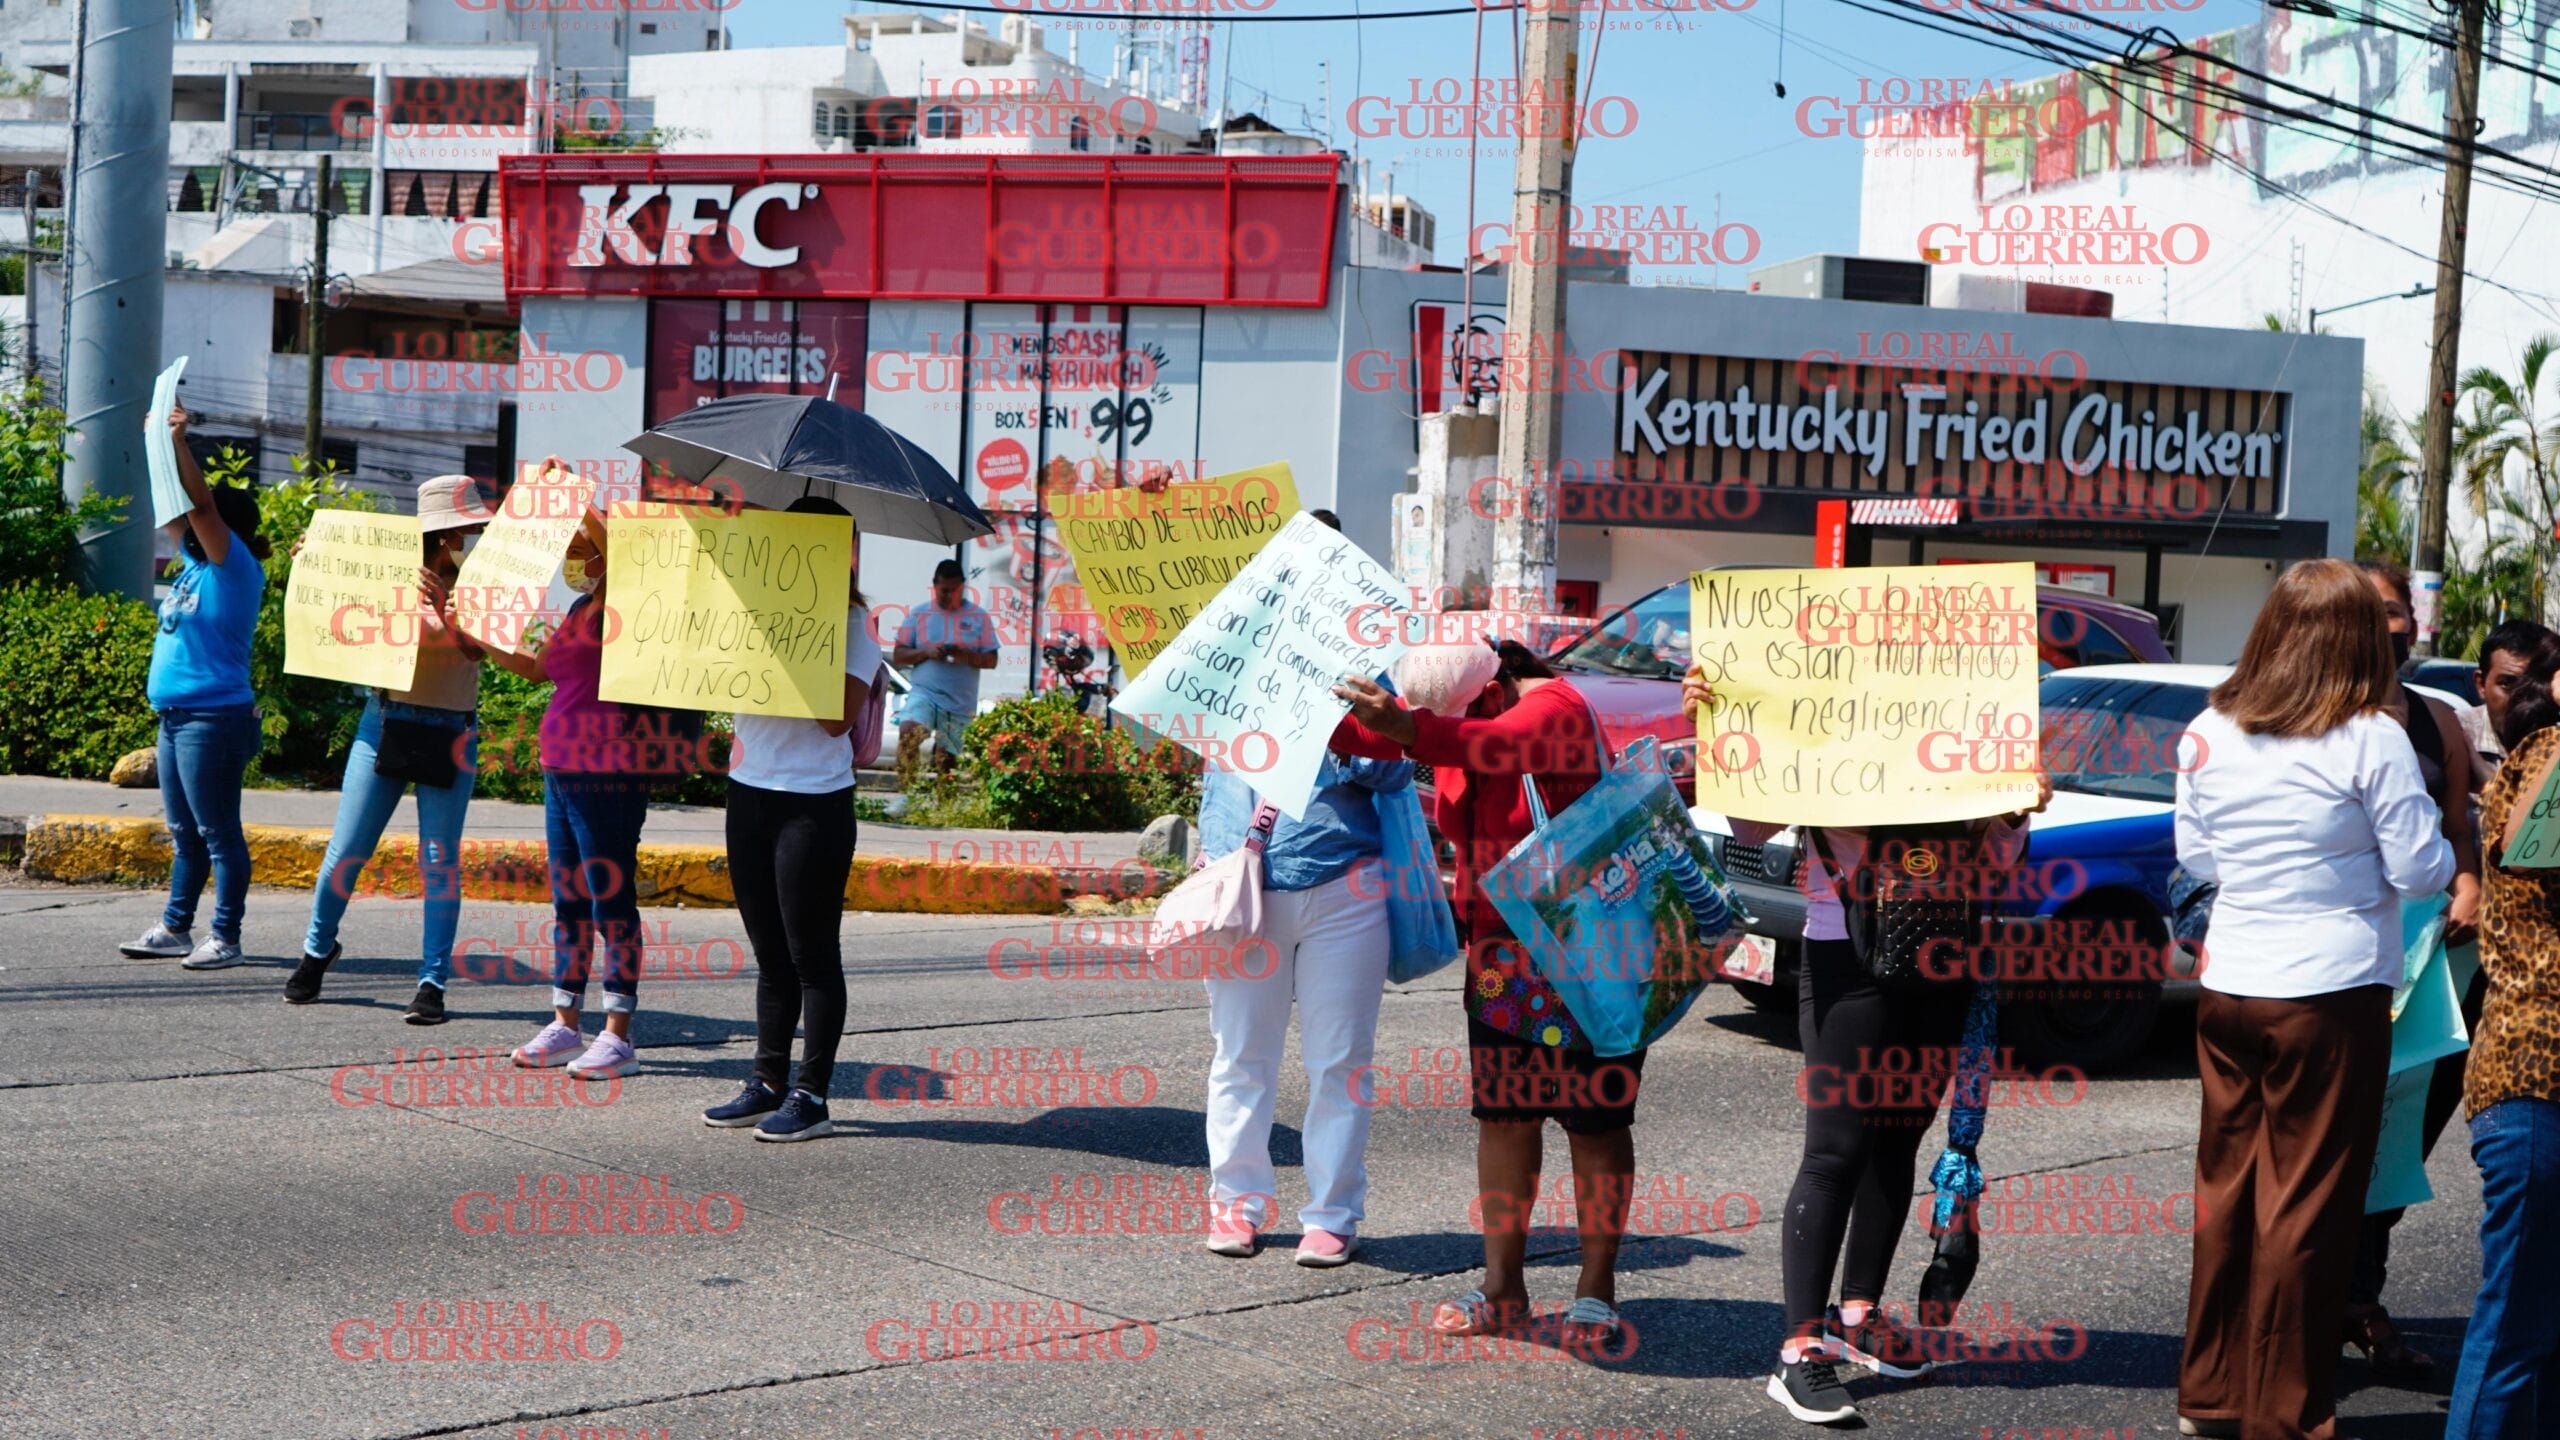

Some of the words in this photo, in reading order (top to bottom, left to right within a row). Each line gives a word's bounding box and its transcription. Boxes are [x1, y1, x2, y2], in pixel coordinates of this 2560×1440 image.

[568, 182, 804, 268] KFC
[693, 345, 826, 384] BURGERS
[995, 411, 1026, 429] BOX
[1028, 408, 1038, 429] 5
[1045, 406, 1068, 429] EN
[1070, 408, 1077, 429] 1
[1622, 365, 1889, 478] Kentucky
[1902, 384, 2045, 467] Fried
[2061, 394, 2274, 478] Chicken
[352, 525, 364, 545] DE
[1069, 516, 1146, 553] CAMBIO
[1151, 507, 1182, 544] DE
[1182, 496, 1282, 543] TURNOS
[296, 584, 325, 607] NOCHE
[322, 556, 332, 574] EL
[364, 563, 373, 580] DE
[375, 564, 384, 581] LA
[629, 525, 828, 614] QUEREMOS
[1088, 566, 1119, 595] EN
[1117, 565, 1155, 596] LOS
[1318, 543, 1350, 570] de
[1341, 560, 1421, 630] Sangre
[633, 589, 836, 666] QUIMIOTERAPIA
[1108, 604, 1168, 631] CAMAS
[1169, 602, 1193, 631] DE
[1267, 551, 1302, 591] Para
[1300, 569, 1396, 650] Pacientes
[1884, 573, 1992, 632] hijos
[1206, 604, 1248, 637] con
[1252, 617, 1284, 659] el
[1292, 599, 1312, 632] de
[1311, 615, 1381, 676] Caracter
[652, 656, 773, 705] NIÑOS
[1766, 634, 1855, 685] estan
[1257, 668, 1281, 703] de
[1290, 684, 1315, 730] las
[1709, 692, 1762, 738] Por
[1789, 691, 2001, 742] negligencia
